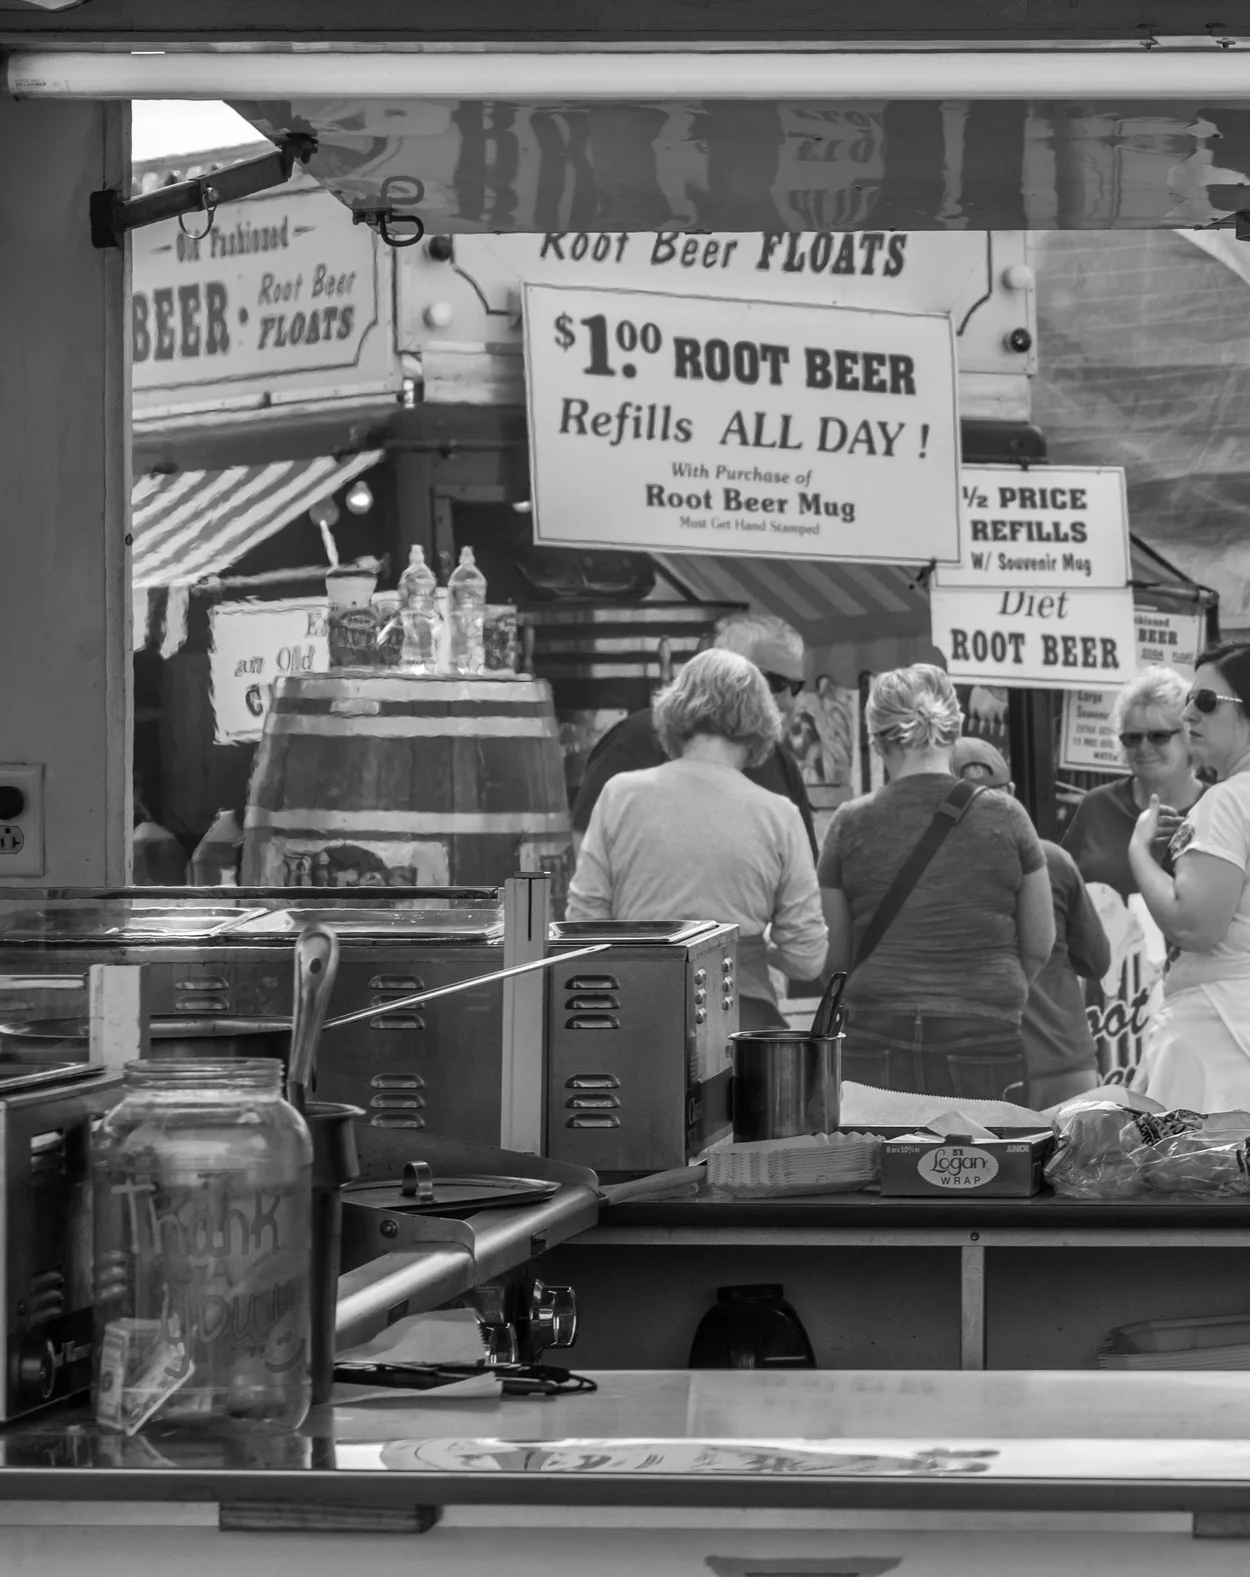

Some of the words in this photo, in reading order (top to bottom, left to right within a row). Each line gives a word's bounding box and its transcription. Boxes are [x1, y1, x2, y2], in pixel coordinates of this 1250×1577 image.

[210, 216, 289, 260] Fashioned
[540, 232, 629, 262] Root
[650, 232, 738, 269] Beer
[756, 232, 908, 277] FLOATS
[257, 273, 304, 306] Root
[311, 263, 357, 299] Beer
[132, 281, 230, 363] BEER
[257, 305, 355, 350] FLOATS
[673, 336, 790, 386] ROOT
[804, 346, 916, 396] BEER
[558, 397, 694, 447] Refills
[719, 410, 804, 451] ALL
[816, 416, 906, 457] DAY
[672, 462, 710, 480] With
[715, 465, 790, 485] Purchase
[795, 469, 815, 487] of
[645, 483, 716, 511] Root
[722, 487, 788, 515] Beer
[797, 492, 856, 523] Mug
[998, 487, 1087, 511] PRICE
[679, 515, 707, 531] Must
[711, 517, 732, 532] Get
[735, 518, 768, 533] Hand
[770, 520, 821, 537] Stamped
[970, 519, 1088, 544] REFILLS
[999, 552, 1057, 573] Souvenir
[1062, 554, 1092, 578] Mug
[996, 590, 1071, 619] Diet
[950, 629, 1025, 665] ROOT
[1041, 634, 1119, 669] BEER
[1138, 628, 1178, 645] BEER
[930, 1149, 988, 1176] Logan
[941, 1176, 981, 1185] WRAP
[111, 1177, 283, 1258] Thank
